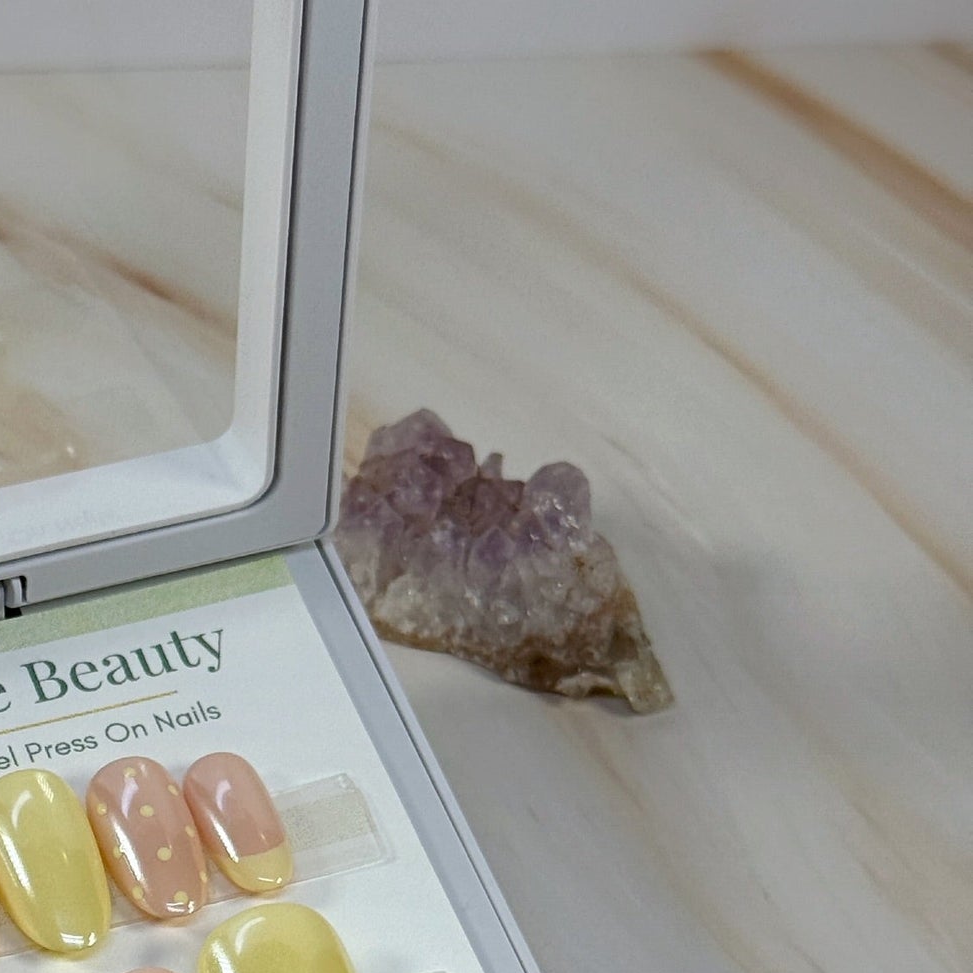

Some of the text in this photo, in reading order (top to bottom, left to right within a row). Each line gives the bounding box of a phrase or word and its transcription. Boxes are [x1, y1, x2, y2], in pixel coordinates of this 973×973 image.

[20, 626, 226, 705] Beauty
[24, 736, 98, 763] Press
[105, 723, 148, 742] On
[153, 701, 221, 732] Nails
